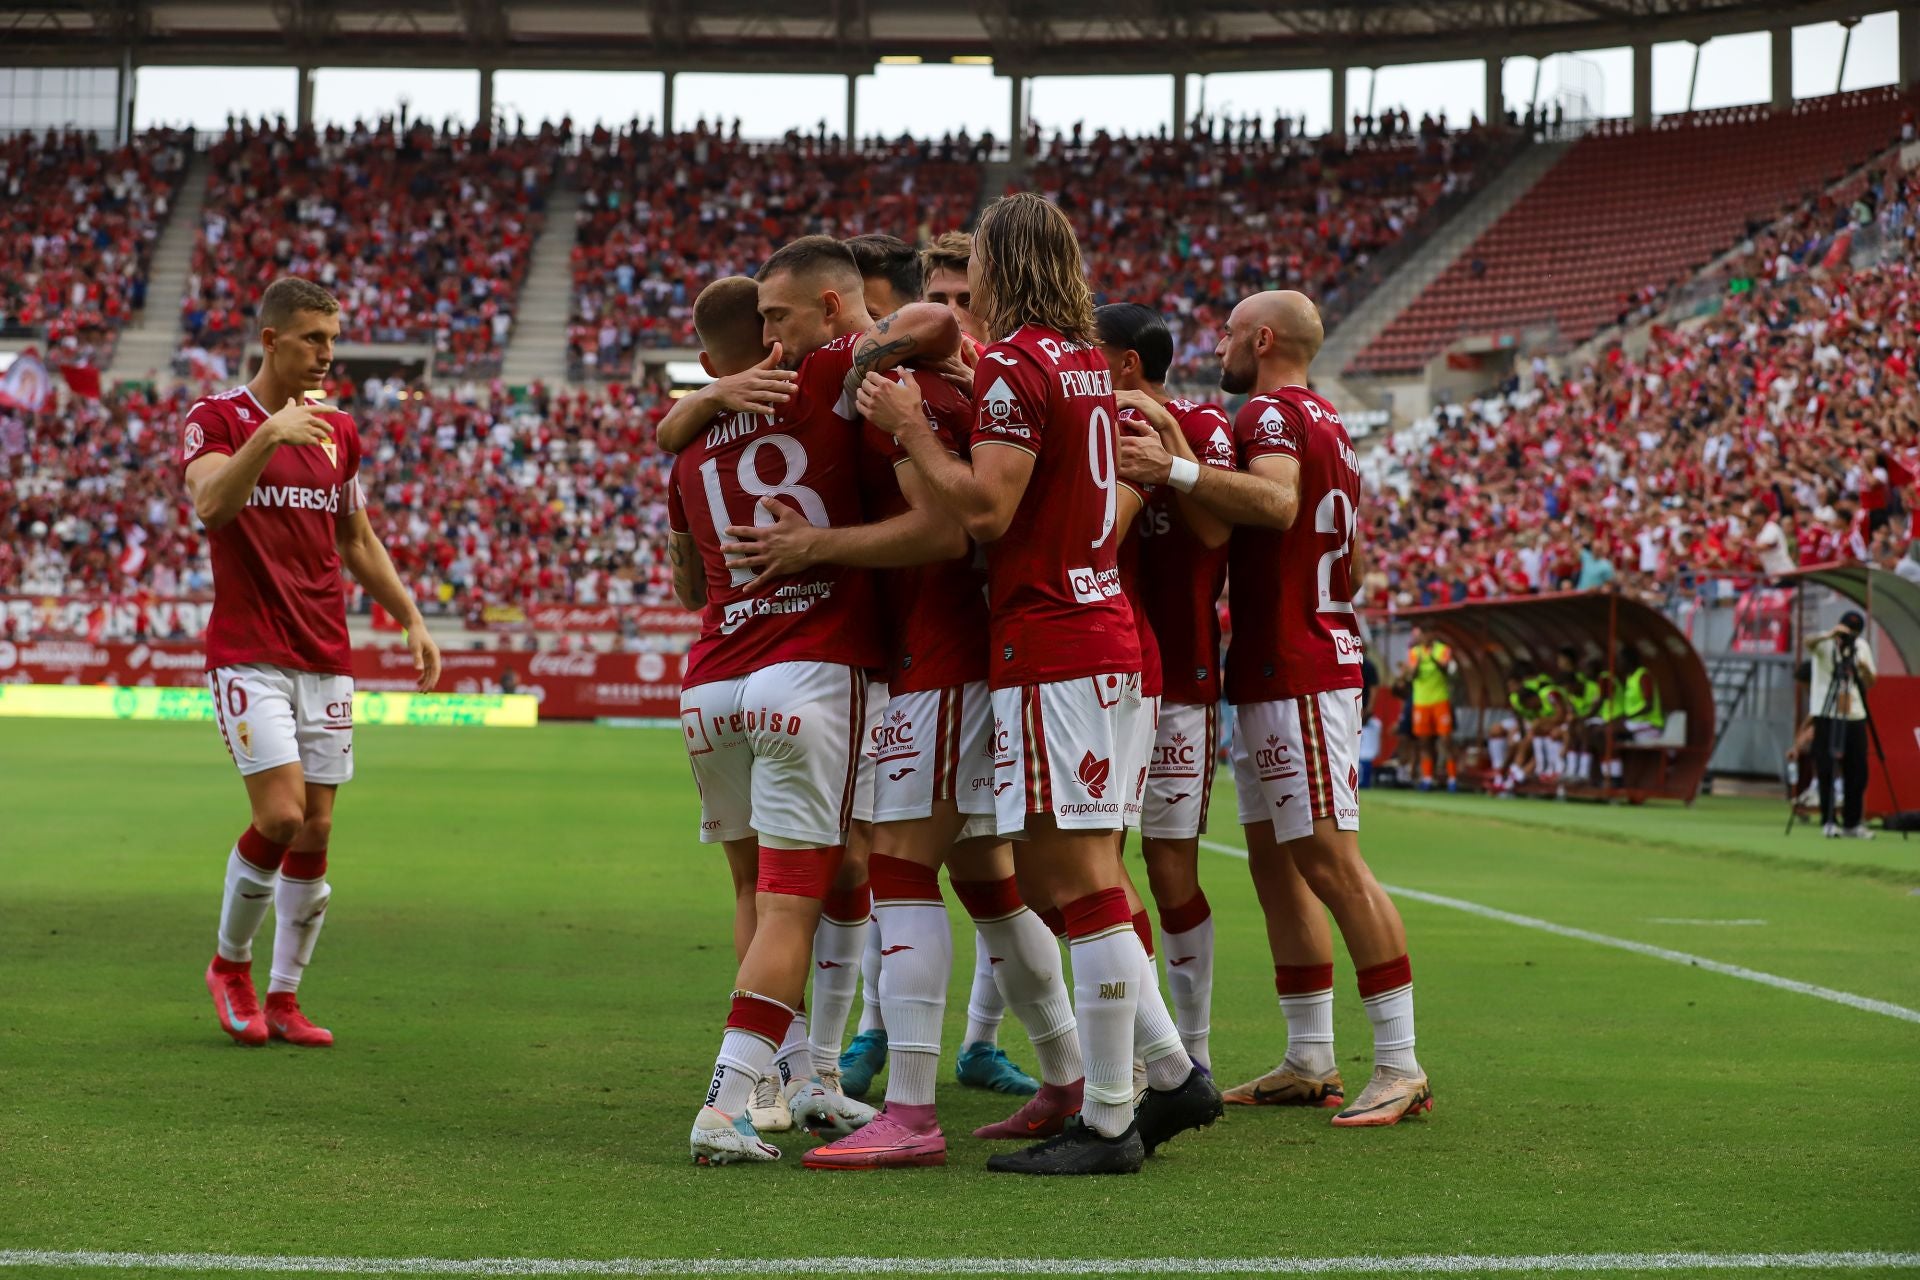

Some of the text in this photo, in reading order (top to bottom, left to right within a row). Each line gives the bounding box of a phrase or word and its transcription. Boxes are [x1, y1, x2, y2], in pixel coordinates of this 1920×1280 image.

[1089, 406, 1117, 548] 9
[699, 434, 830, 587] 18
[1315, 489, 1358, 613] 2
[226, 676, 248, 717] 6
[713, 707, 801, 736] repiso
[1256, 745, 1291, 768] CRC
[1060, 800, 1119, 816] grupolucas
[705, 1081, 721, 1107] NEO
